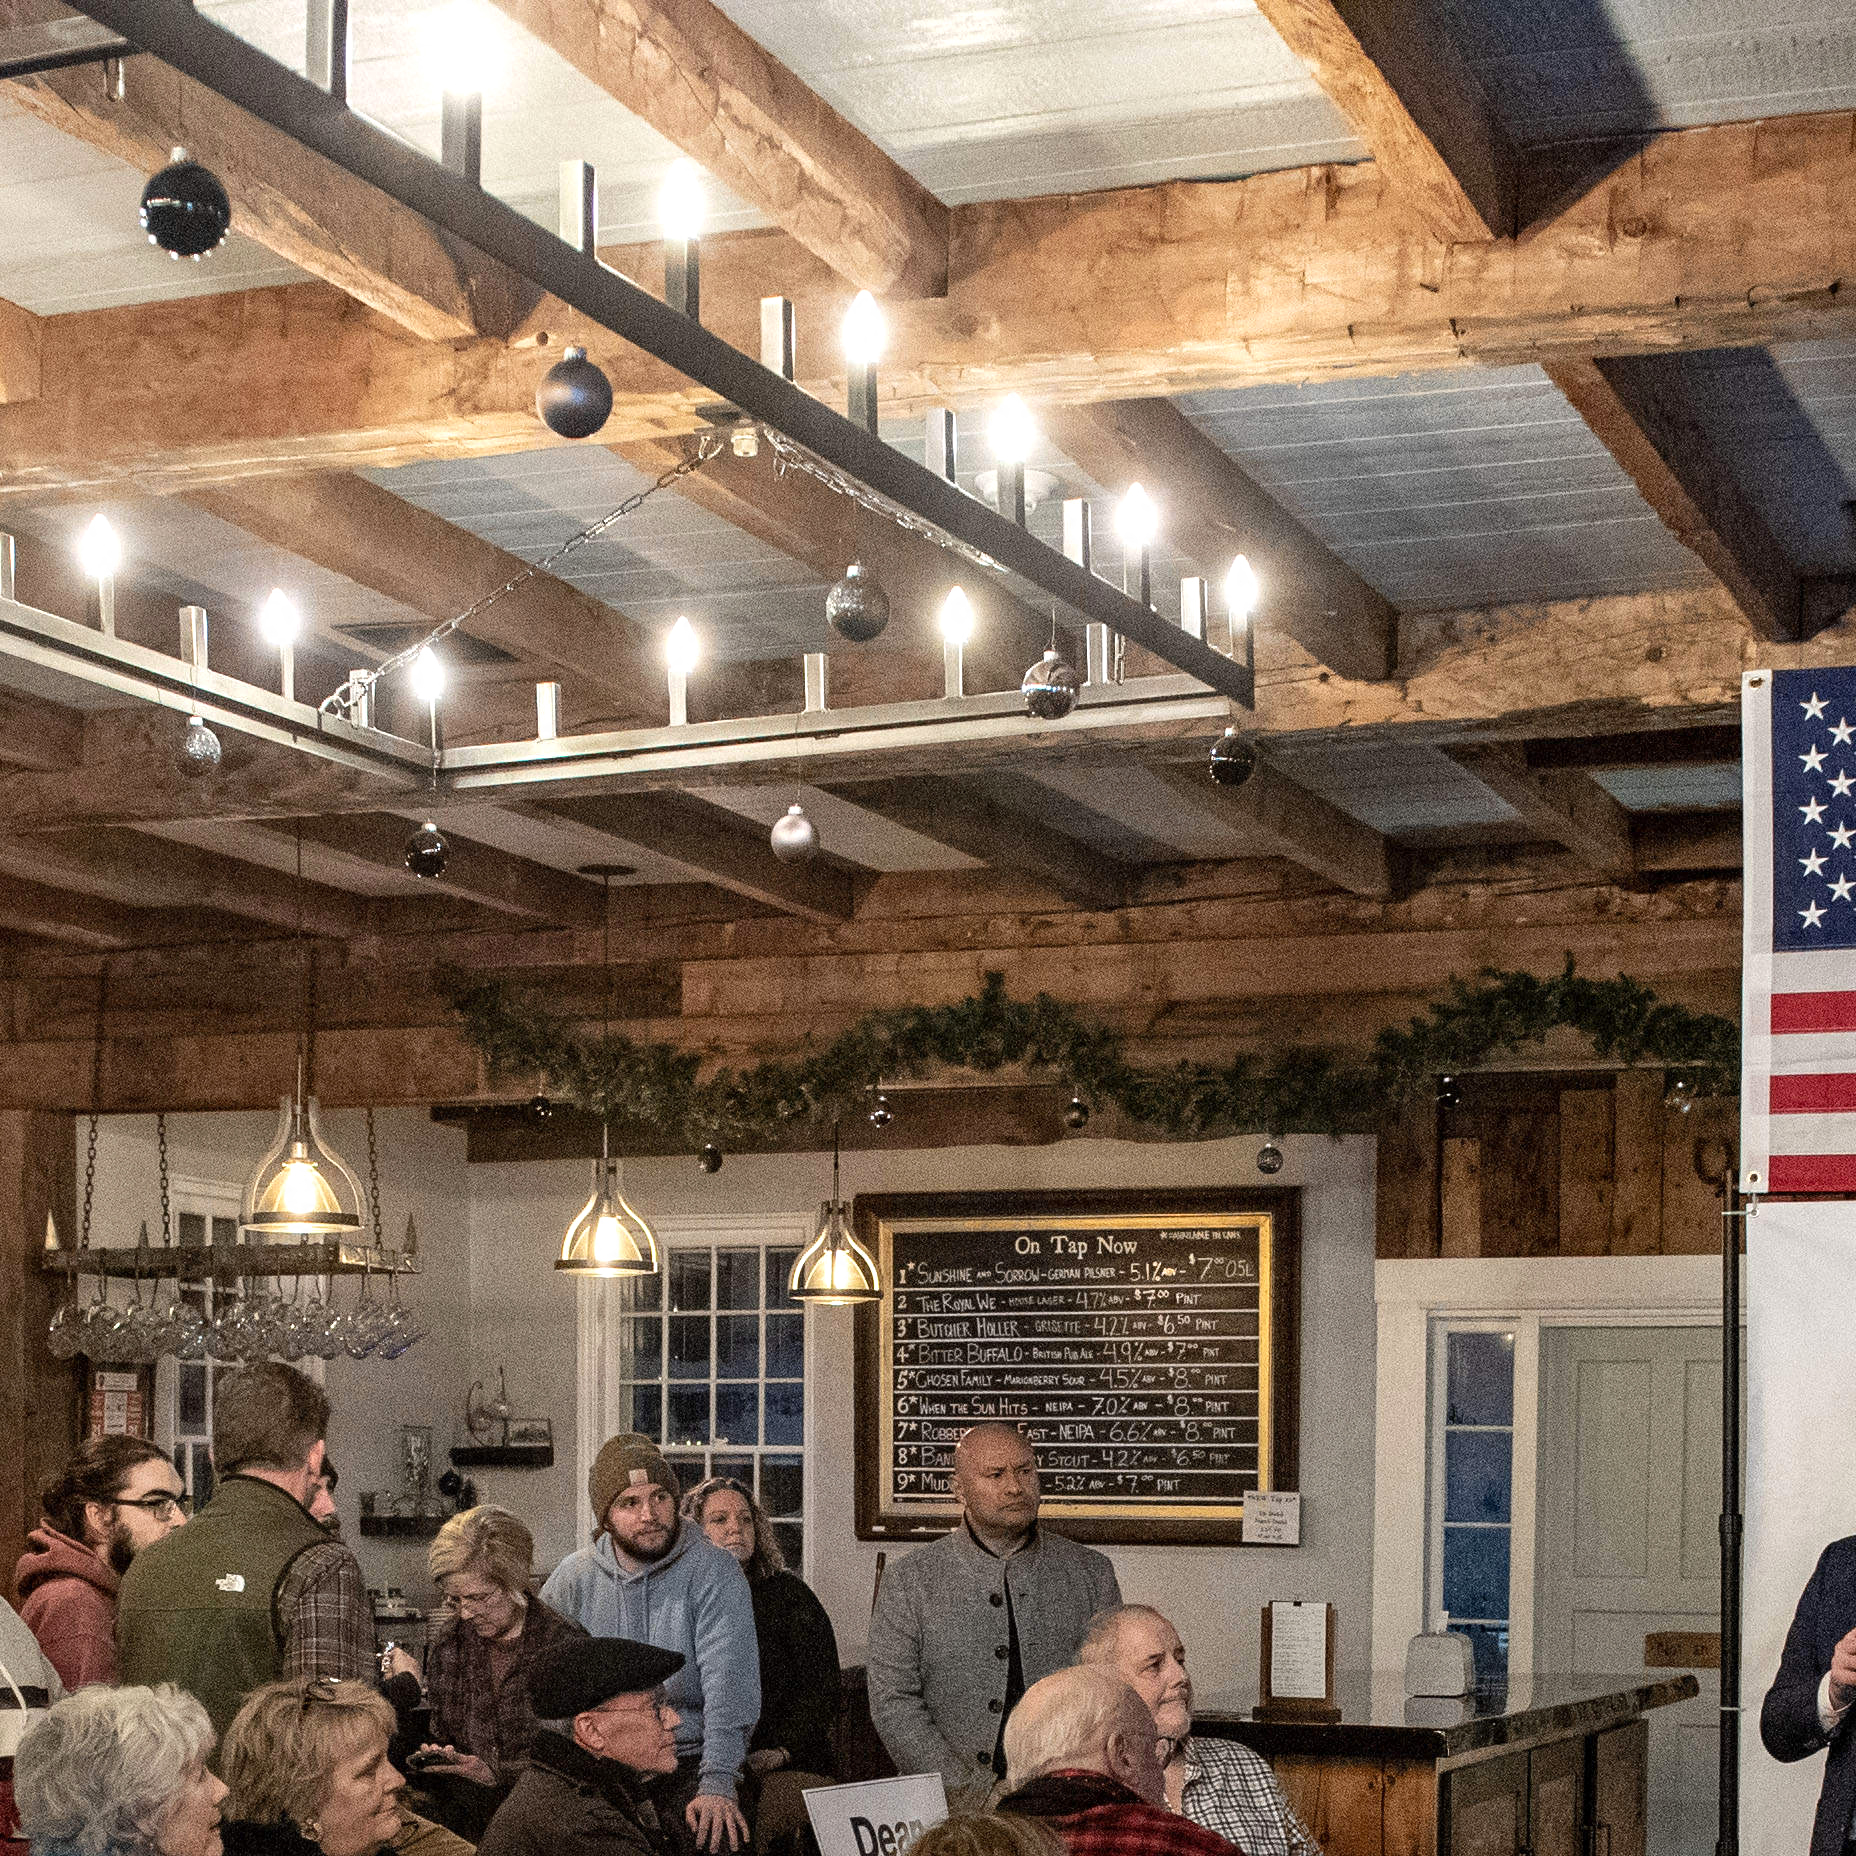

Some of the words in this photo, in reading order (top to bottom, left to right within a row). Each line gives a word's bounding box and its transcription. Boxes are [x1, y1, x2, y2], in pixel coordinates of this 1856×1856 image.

[1015, 1236, 1042, 1255] On
[1050, 1235, 1088, 1260] Tap
[1096, 1236, 1138, 1255] Now
[917, 1262, 974, 1286] SUNSHINE
[976, 1271, 993, 1280] AND
[995, 1261, 1042, 1285] SORROW
[1084, 1266, 1116, 1279] PILSNER
[1130, 1261, 1162, 1282] 5.1%
[897, 1295, 908, 1310] 2
[915, 1295, 941, 1313] THE
[941, 1293, 976, 1313] ROYAL
[976, 1293, 997, 1311] WE
[1036, 1295, 1066, 1306] LAGER
[1175, 1292, 1202, 1306] PINT
[916, 1318, 972, 1339] BUTCHER
[975, 1317, 1021, 1339] HOLLER
[1034, 1319, 1081, 1334] GRISETTE
[1195, 1318, 1220, 1331] PINT
[918, 1343, 963, 1364] BITTER
[966, 1342, 1023, 1364] BUFFALO
[1032, 1347, 1062, 1360] BRITISH
[1063, 1347, 1079, 1361] PUB
[1079, 1349, 1094, 1360] ALE
[1202, 1347, 1220, 1358] PINT
[915, 1369, 959, 1389] CHOSEN
[960, 1369, 993, 1387] FAMILY
[1061, 1373, 1086, 1387] SOUR
[1098, 1367, 1143, 1389] 4.5%
[1204, 1374, 1228, 1386] PINT
[919, 1396, 947, 1415] WHEN
[950, 1406, 969, 1416] THE
[971, 1395, 996, 1415] SUN
[999, 1396, 1029, 1416] HITS
[1045, 1402, 1074, 1413] NEIPA
[1091, 1396, 1131, 1416] 7.0%
[1205, 1401, 1230, 1413] PINT
[1059, 1424, 1095, 1440] NEIPA
[1109, 1421, 1153, 1442] 6.6%
[1212, 1426, 1236, 1440] PINT
[1047, 1450, 1091, 1468] STOUT
[1157, 1478, 1182, 1491] PINT
